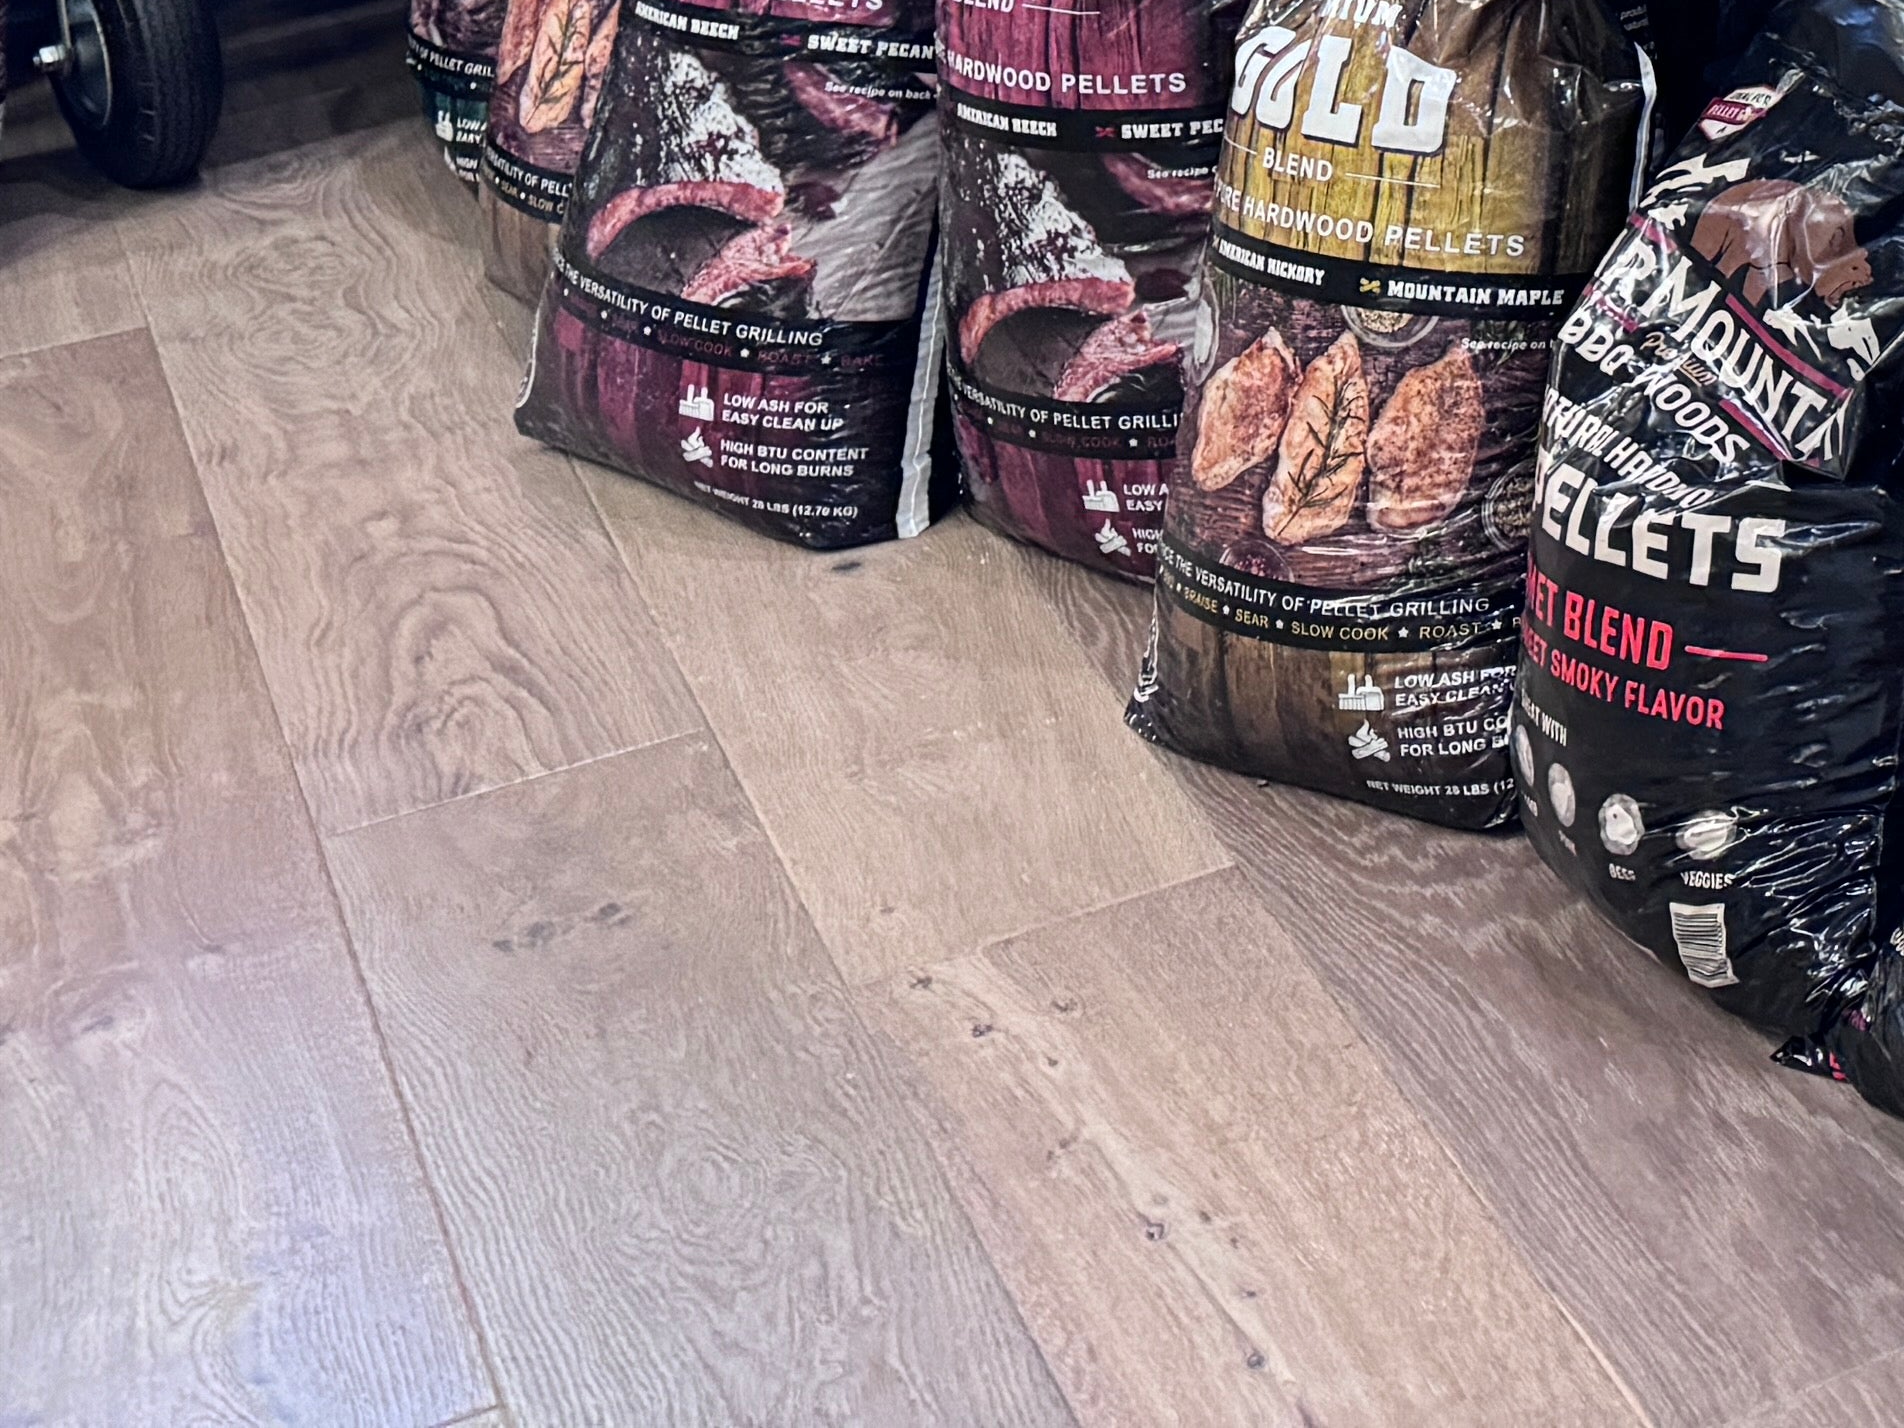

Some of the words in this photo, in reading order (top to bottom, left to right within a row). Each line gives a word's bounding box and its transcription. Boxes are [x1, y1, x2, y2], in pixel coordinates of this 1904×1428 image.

[807, 33, 870, 58] SWEET
[946, 53, 1051, 93] HARDWOOD
[1061, 73, 1187, 96] PELLETS
[1231, 26, 1457, 156] GOLD
[1121, 122, 1183, 140] SWEET
[1262, 146, 1334, 183] BLEND
[1243, 197, 1374, 243] HARDWOOD
[1384, 226, 1525, 257] PELLETS
[1266, 257, 1326, 286] HICKORY
[1387, 280, 1491, 305] MOUNTAIN
[1497, 287, 1565, 307] MAPLE
[650, 302, 670, 323] OF
[673, 310, 732, 337] PELLET
[735, 321, 823, 347] GRILLING
[724, 393, 756, 410] LOW
[758, 397, 789, 412] ASH
[794, 401, 829, 414] FOR
[722, 410, 759, 426] EASY
[762, 416, 816, 431] CLEAN
[821, 418, 844, 430] UP
[1030, 408, 1049, 424] OF
[1053, 413, 1112, 429] PELLET
[720, 439, 753, 455] HIGH
[757, 444, 787, 459] BTU
[792, 448, 869, 461] CONTENT
[721, 455, 747, 470] FOR
[752, 461, 793, 475] LONG
[797, 465, 854, 477] BURNS
[1123, 483, 1156, 497] LOW
[1126, 498, 1163, 512] EASY
[1195, 566, 1277, 608] VERSATILITY
[1281, 591, 1305, 611] OF
[1310, 598, 1380, 618] PELLET
[1389, 596, 1491, 617] GRILLING
[1235, 608, 1269, 628] SEAR
[1291, 621, 1337, 639] SLOW
[1339, 625, 1389, 642] COOK
[1564, 590, 1674, 672] BLEND
[1395, 674, 1435, 688] LOW
[1440, 671, 1475, 685] ASH
[1550, 642, 1619, 705] SMOKY
[1624, 676, 1725, 732] FLAVOR
[1395, 693, 1440, 706] EASY
[1398, 725, 1438, 738] HIGH
[1443, 721, 1478, 736] BTU
[1401, 744, 1434, 757] FOR
[1439, 738, 1486, 755] LONG
[1464, 784, 1489, 795] LBS
